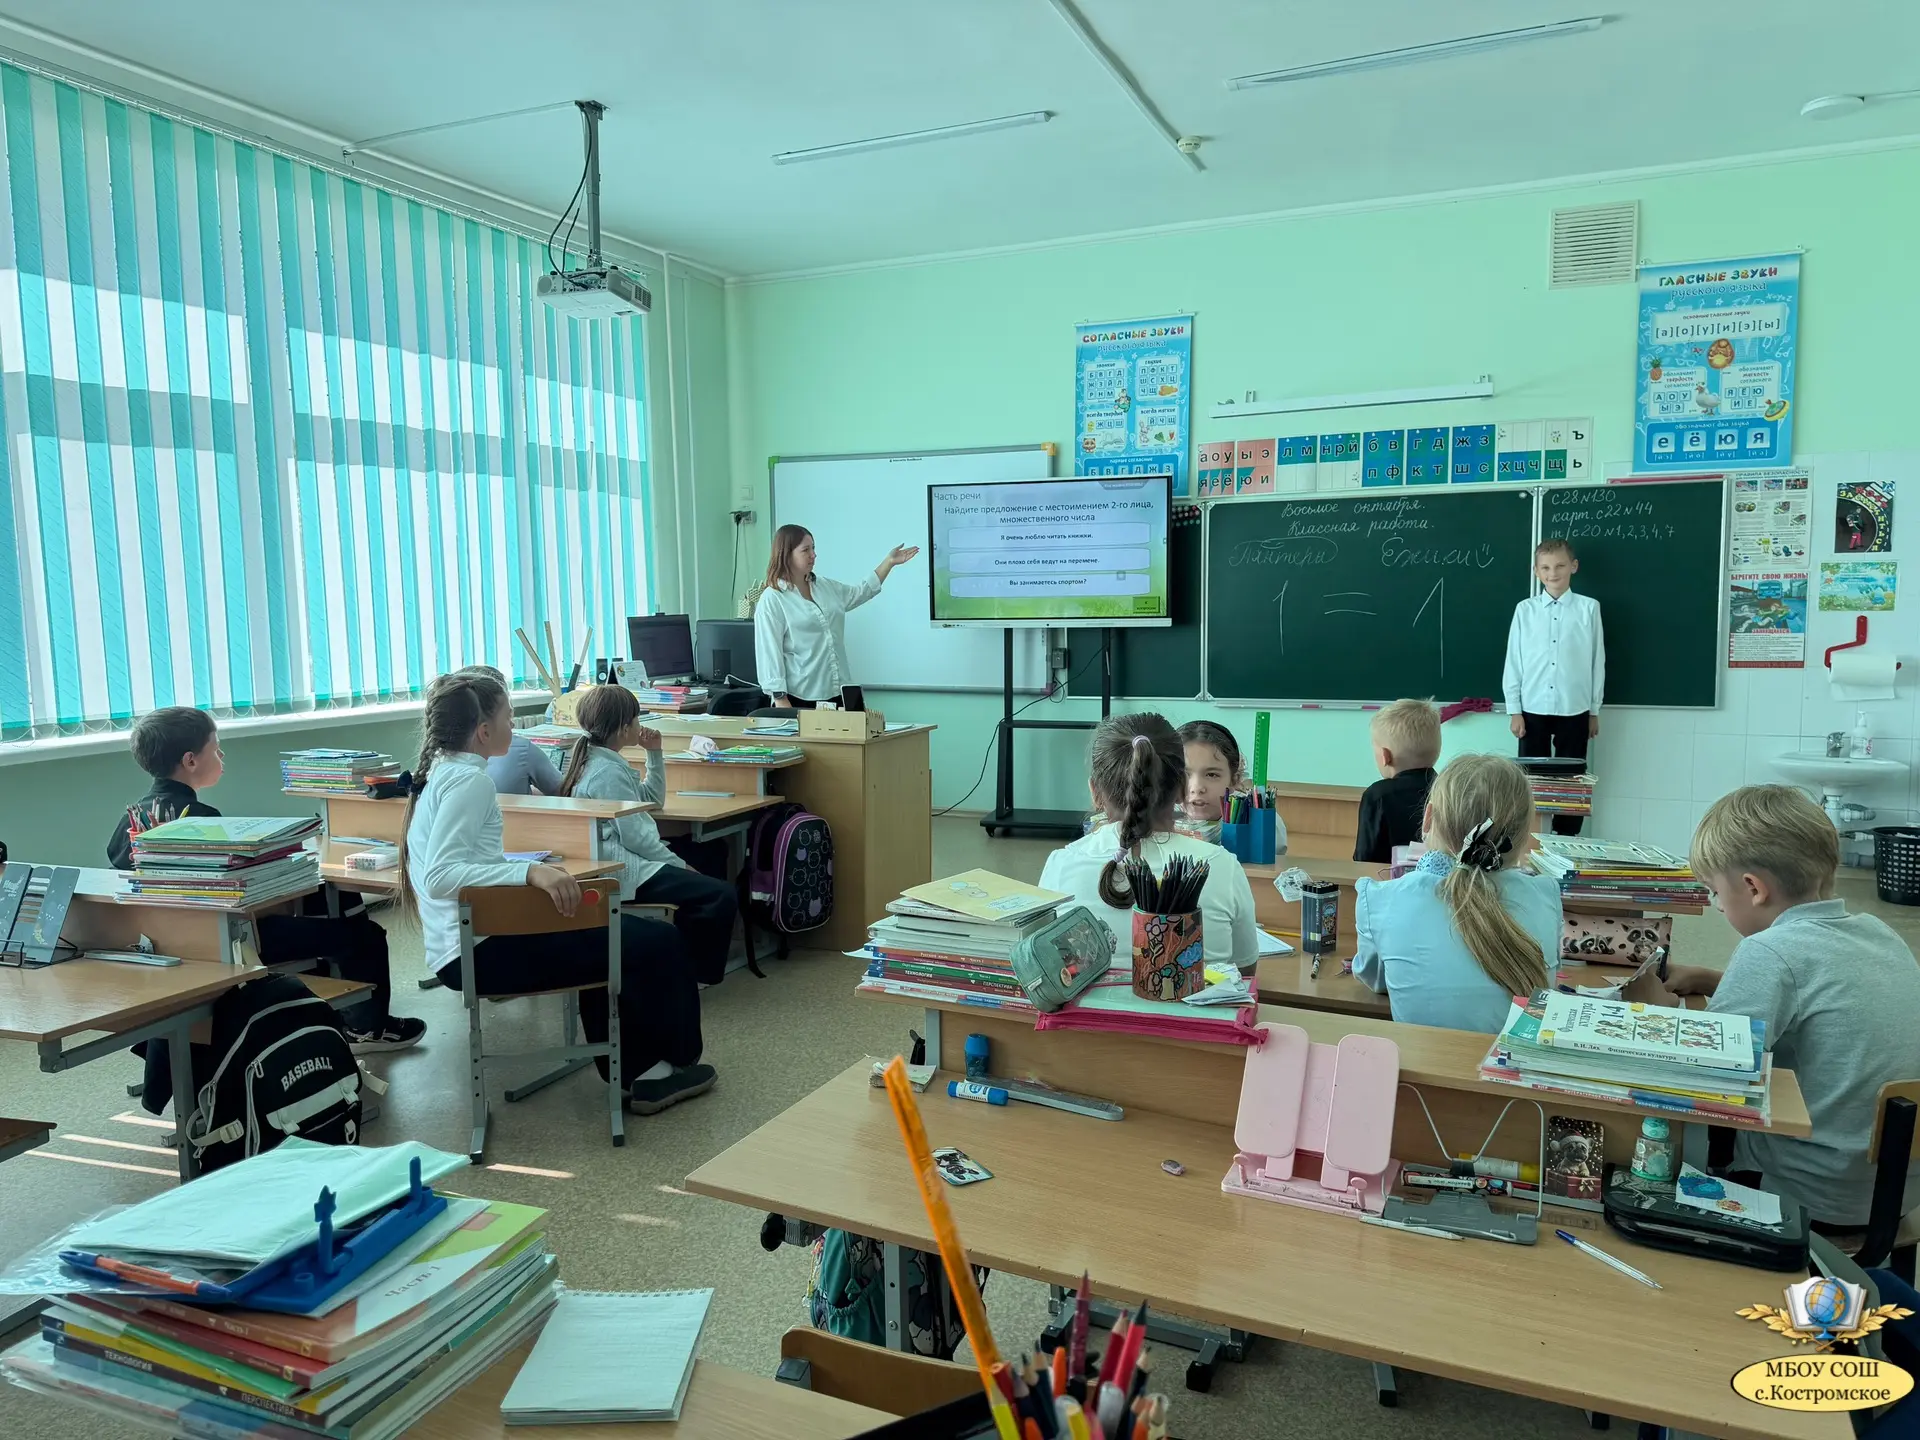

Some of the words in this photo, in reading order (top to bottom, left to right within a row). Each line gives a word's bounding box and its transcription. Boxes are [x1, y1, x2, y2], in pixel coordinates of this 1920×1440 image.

[1659, 272, 1726, 286] ГЛАСНЫЕ
[1731, 267, 1777, 280] ЗВУКИ
[1671, 286, 1726, 300] русского
[1730, 283, 1767, 292] языка
[1082, 329, 1147, 343] СОГЛАСНЫЕ
[1150, 326, 1184, 337] ЗВУКИ
[1200, 453, 1207, 462] а
[1212, 452, 1220, 461] о
[1224, 451, 1232, 463] у
[1242, 450, 1252, 459] ы
[1262, 449, 1270, 458] э
[1283, 447, 1292, 457] л
[1302, 446, 1312, 455] м
[1322, 445, 1331, 454] н
[1335, 444, 1344, 455] р
[1349, 441, 1358, 453] й
[1369, 439, 1378, 451] б
[1389, 440, 1397, 449] в
[1414, 440, 1421, 449] г
[1433, 439, 1443, 450] д
[1456, 437, 1470, 446] ж
[1480, 436, 1488, 445] з
[1573, 431, 1584, 440] ъ
[1658, 437, 1669, 448] е
[1689, 432, 1700, 447] ё
[1718, 433, 1735, 445] ю
[1753, 432, 1764, 444] я
[1200, 477, 1207, 487] я
[1212, 478, 1220, 486] е
[1224, 474, 1232, 486] ё
[1240, 475, 1252, 485] ю
[1261, 475, 1269, 484] и
[1368, 468, 1377, 478] п
[1386, 465, 1399, 478] ф
[1412, 466, 1421, 476] к
[1433, 465, 1441, 474] т
[1455, 464, 1469, 474] ш
[1479, 464, 1488, 473] с
[1501, 462, 1509, 472] х
[1514, 462, 1525, 473] ц
[1529, 460, 1539, 470] ч
[1548, 460, 1563, 471] щ
[1573, 460, 1582, 468] ь
[934, 492, 957, 501] Часть
[960, 492, 981, 501] речи
[944, 506, 979, 514] Найдите
[981, 504, 1037, 514] предложение
[1045, 503, 1109, 511] местоимением
[1111, 501, 1127, 510] 2-го
[1130, 500, 1154, 509] лица,
[1281, 503, 1340, 518] Восьмое
[1353, 497, 1425, 518] октября.
[999, 515, 1069, 523] множественного
[1287, 521, 1360, 536] Классная
[1367, 518, 1434, 538] работа.
[904, 970, 933, 978] ТЕХНОЛОГИЯ
[1607, 1047, 1646, 1058] Физическая
[1647, 1052, 1677, 1062] культура
[280, 1055, 333, 1093] BASEBALL
[384, 1272, 432, 1297] Часть
[104, 1350, 153, 1372] ТЕХНОЛОГИЯ
[241, 1392, 295, 1417] ПЕРСПЕКТИВА
